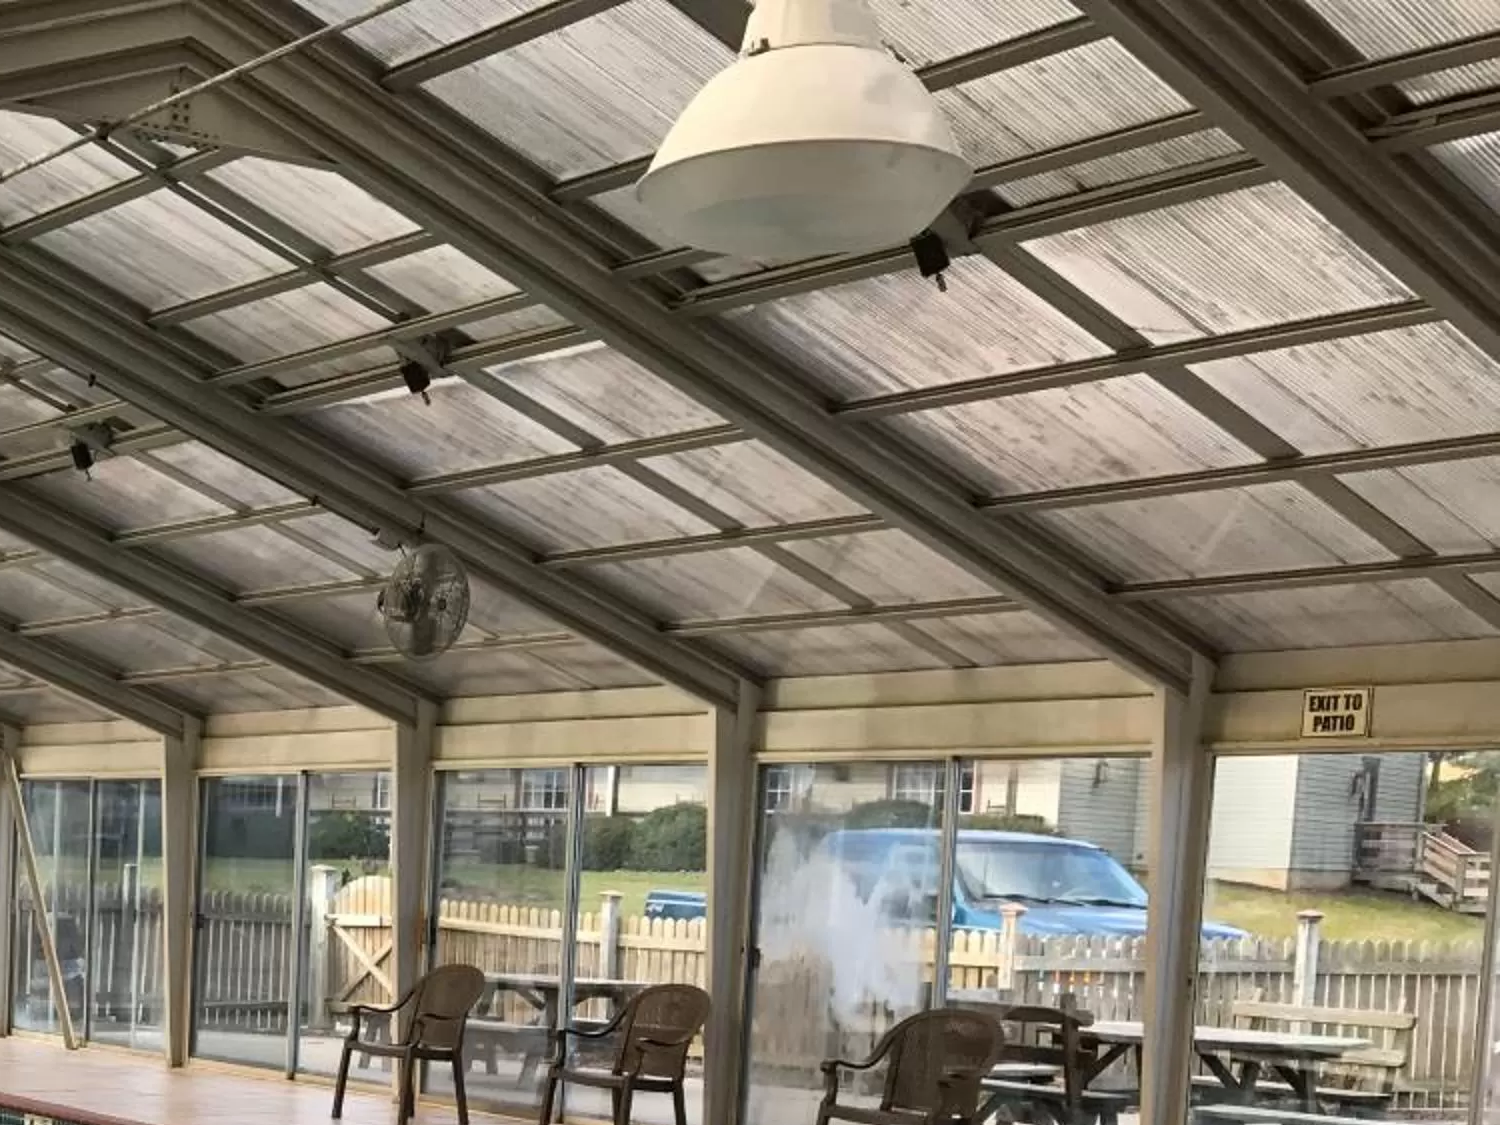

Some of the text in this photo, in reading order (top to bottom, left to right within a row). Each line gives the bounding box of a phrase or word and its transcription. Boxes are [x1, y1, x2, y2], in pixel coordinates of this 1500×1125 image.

[1309, 693, 1362, 712] EXIT TO
[1313, 714, 1355, 732] PATIO
